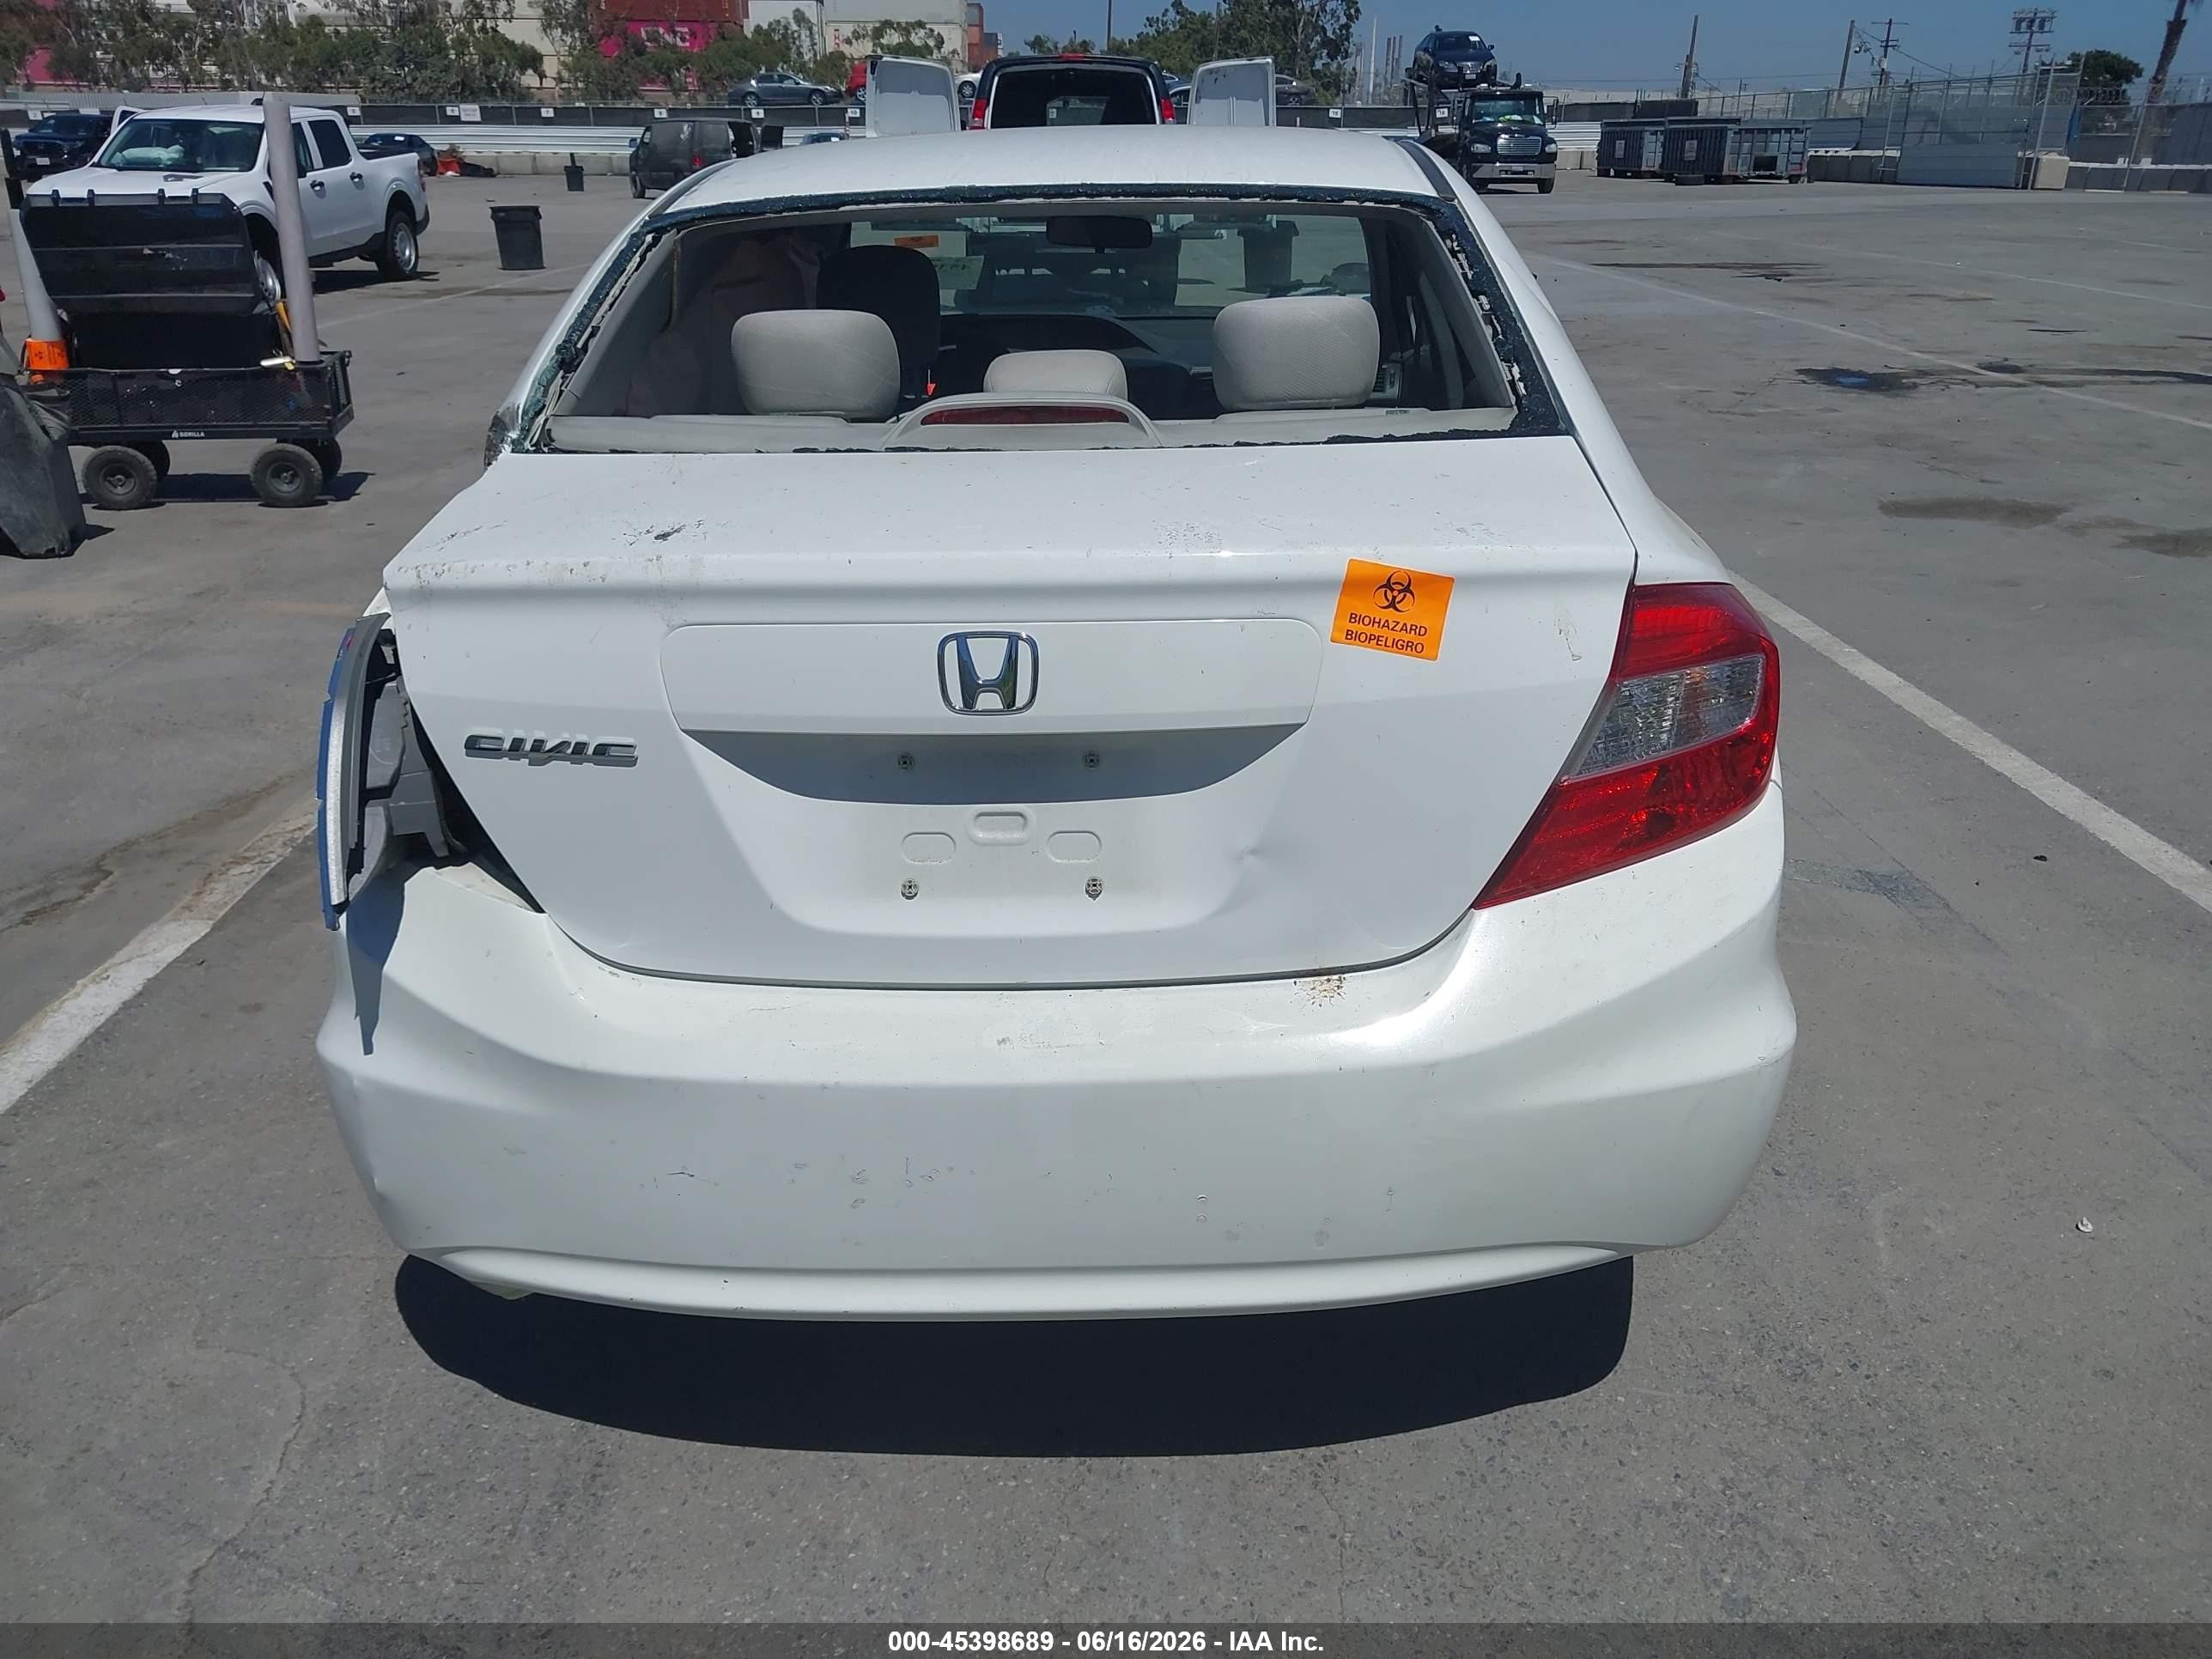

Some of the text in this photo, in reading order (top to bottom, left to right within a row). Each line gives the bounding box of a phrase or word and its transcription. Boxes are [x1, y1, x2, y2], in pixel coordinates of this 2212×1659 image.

[1348, 612, 1428, 637] BIOHAZARD
[1345, 629, 1425, 654] BIOPELIGRO
[464, 734, 638, 767] CIVIC
